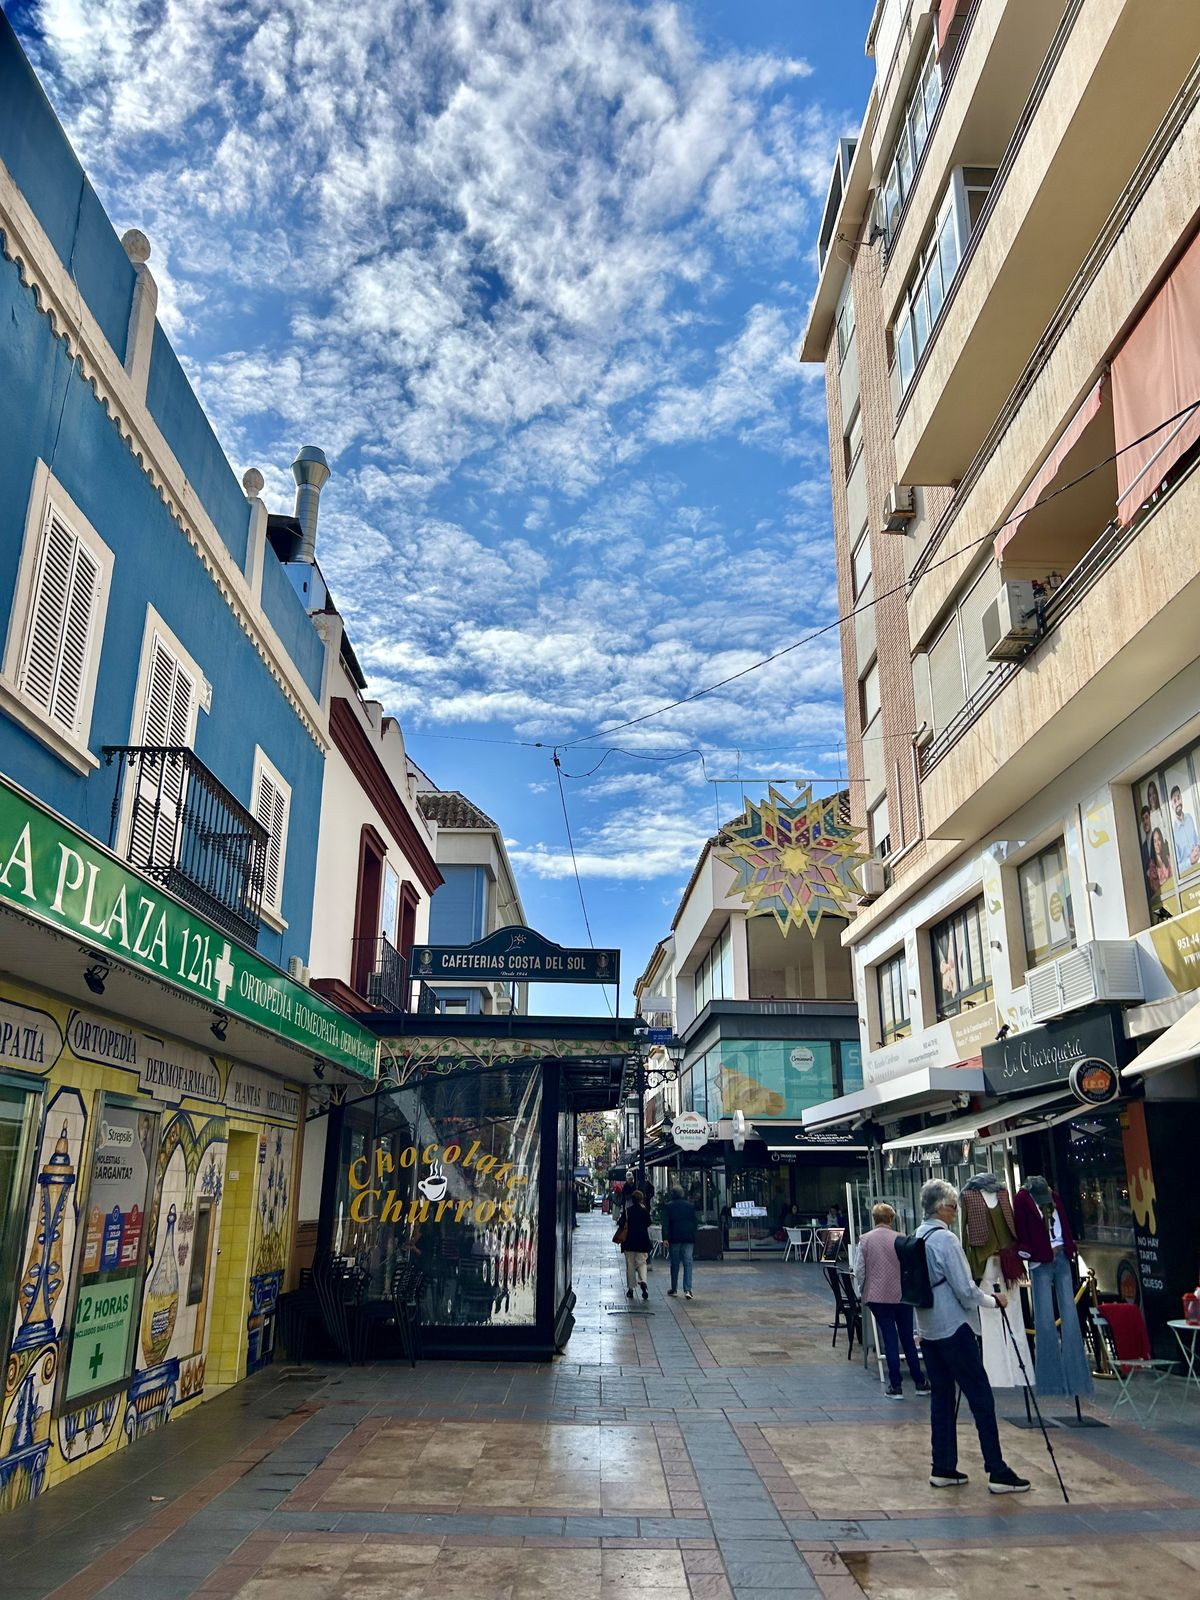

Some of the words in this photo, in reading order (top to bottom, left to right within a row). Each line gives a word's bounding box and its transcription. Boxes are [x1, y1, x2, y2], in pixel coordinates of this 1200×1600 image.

[0, 821, 37, 901] A
[50, 841, 169, 970] PLAZA
[177, 927, 212, 991] 12h
[442, 954, 505, 969] CAFETERIAS
[508, 956, 541, 970] COSTA
[545, 957, 563, 970] DEL
[567, 956, 587, 971] SOL
[0, 1021, 44, 1064] PATÍA
[234, 1081, 261, 1106] PLANTAS
[108, 1128, 132, 1144] Strepsils
[674, 1125, 706, 1135] Croissant
[348, 1140, 528, 1191] Chocolate
[350, 1189, 516, 1224] Churros
[1137, 1236, 1147, 1246] NO
[1147, 1237, 1159, 1248] HAY
[1139, 1250, 1157, 1261] TARTA
[1141, 1264, 1151, 1274] SIN
[1143, 1278, 1163, 1290] QUESO
[77, 1297, 92, 1324] 12
[94, 1294, 129, 1319] HORAS
